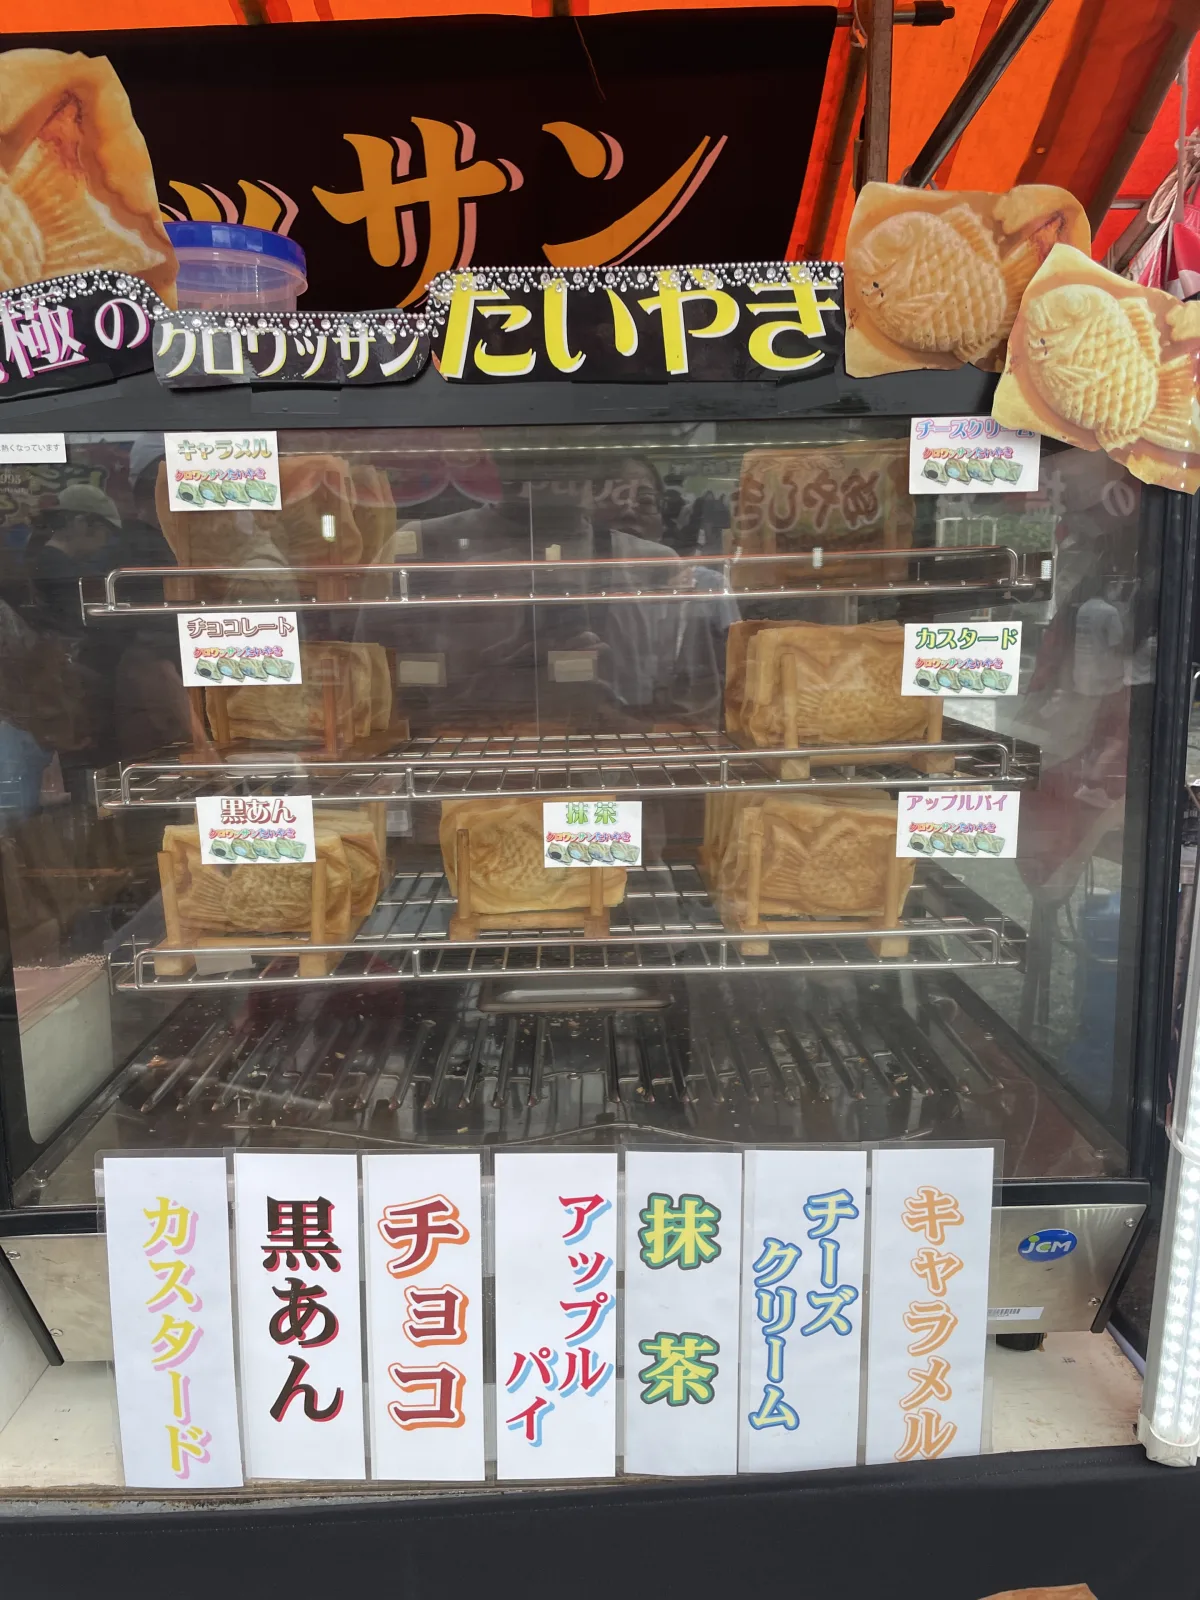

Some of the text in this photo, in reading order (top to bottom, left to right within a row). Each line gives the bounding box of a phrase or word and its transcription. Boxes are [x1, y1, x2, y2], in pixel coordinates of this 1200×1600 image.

[0, 291, 150, 384] 極の
[157, 321, 420, 378] クロワッサン
[441, 265, 843, 379] たいやき
[0, 443, 61, 453] 熱くなっています
[177, 439, 272, 461] キャラメル
[187, 616, 294, 639] チョコレート
[915, 627, 1019, 650] カスタード
[220, 798, 297, 824] 黒あん
[565, 802, 617, 825] 抹茶
[906, 794, 1008, 812] アップルパイ
[260, 1195, 344, 1423] 黒あん
[377, 1194, 470, 1432] チョコ
[557, 1194, 613, 1398] アップル
[638, 1193, 722, 1407] 抹茶
[801, 1189, 859, 1337] チーズ
[142, 1196, 212, 1480] カスタード
[748, 1238, 802, 1431] クリーム
[894, 1185, 965, 1461] キャラメル
[505, 1346, 559, 1448] パイ
